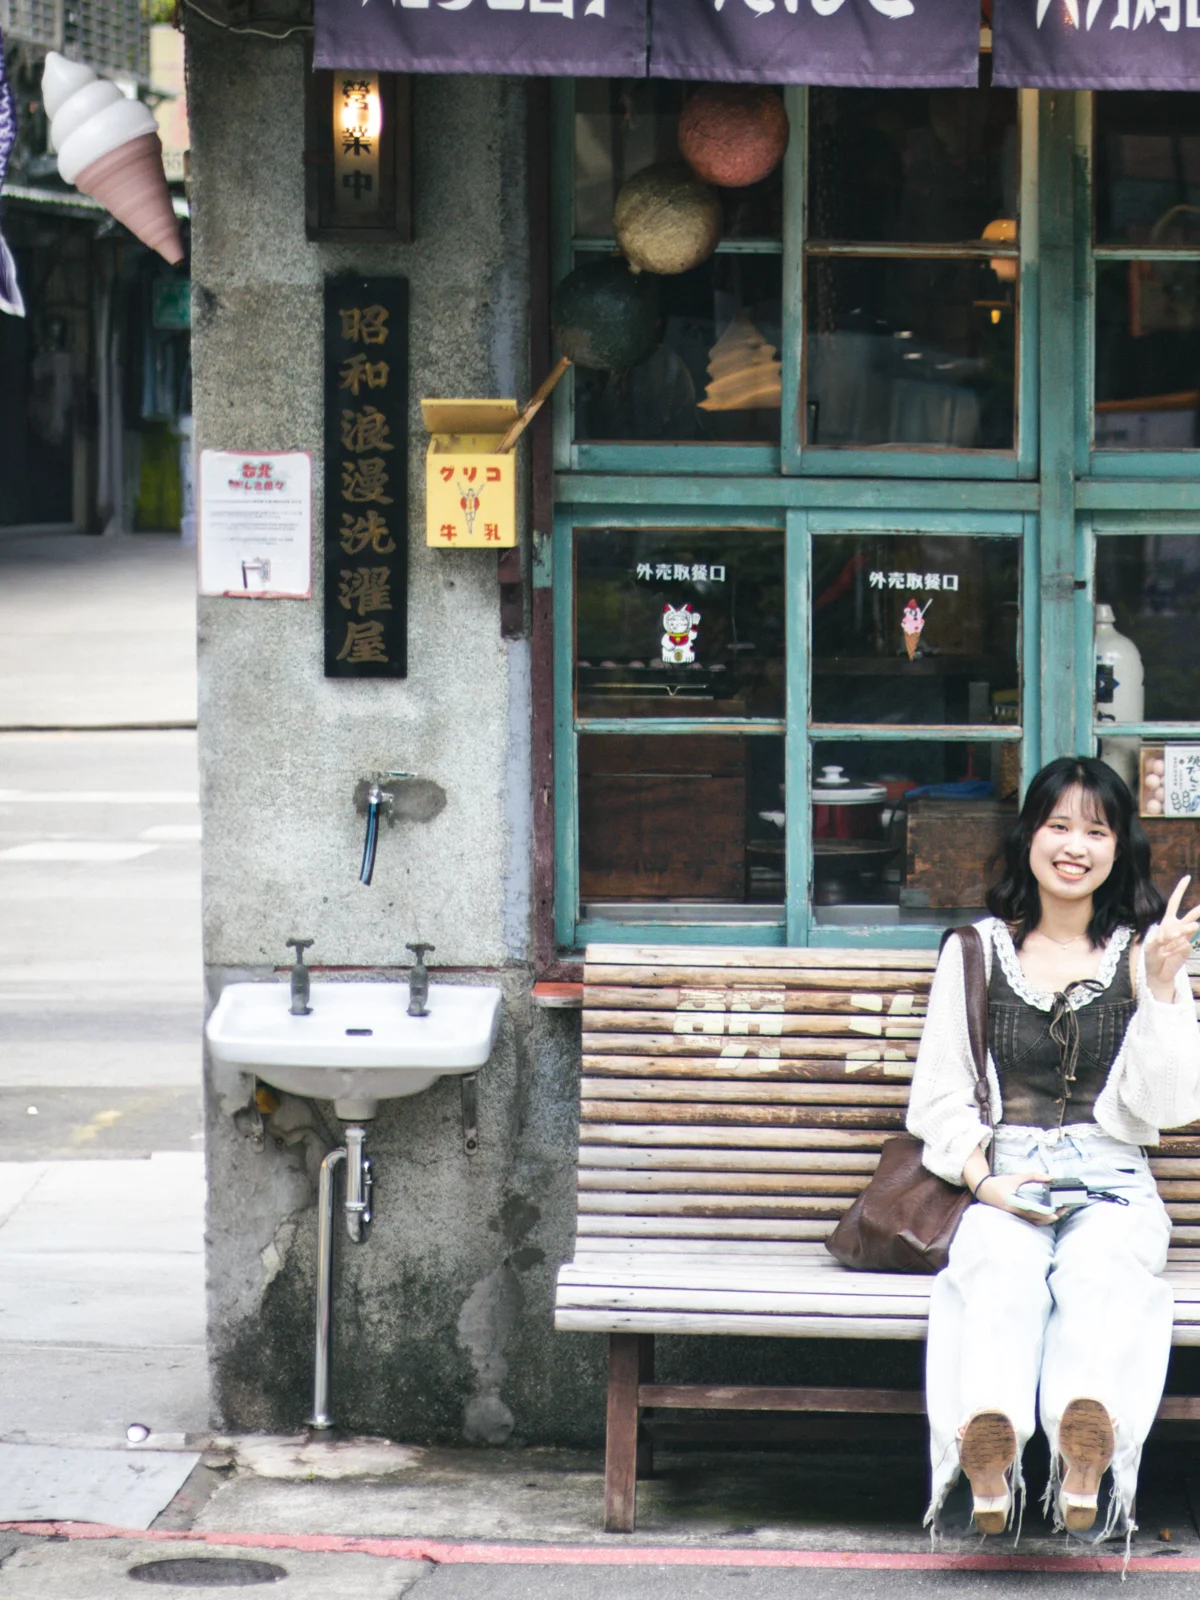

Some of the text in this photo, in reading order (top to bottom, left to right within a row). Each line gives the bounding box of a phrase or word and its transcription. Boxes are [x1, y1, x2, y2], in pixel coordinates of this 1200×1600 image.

[336, 304, 396, 664] 昭和浪漫洗濯屋
[439, 522, 502, 542] 牛乳
